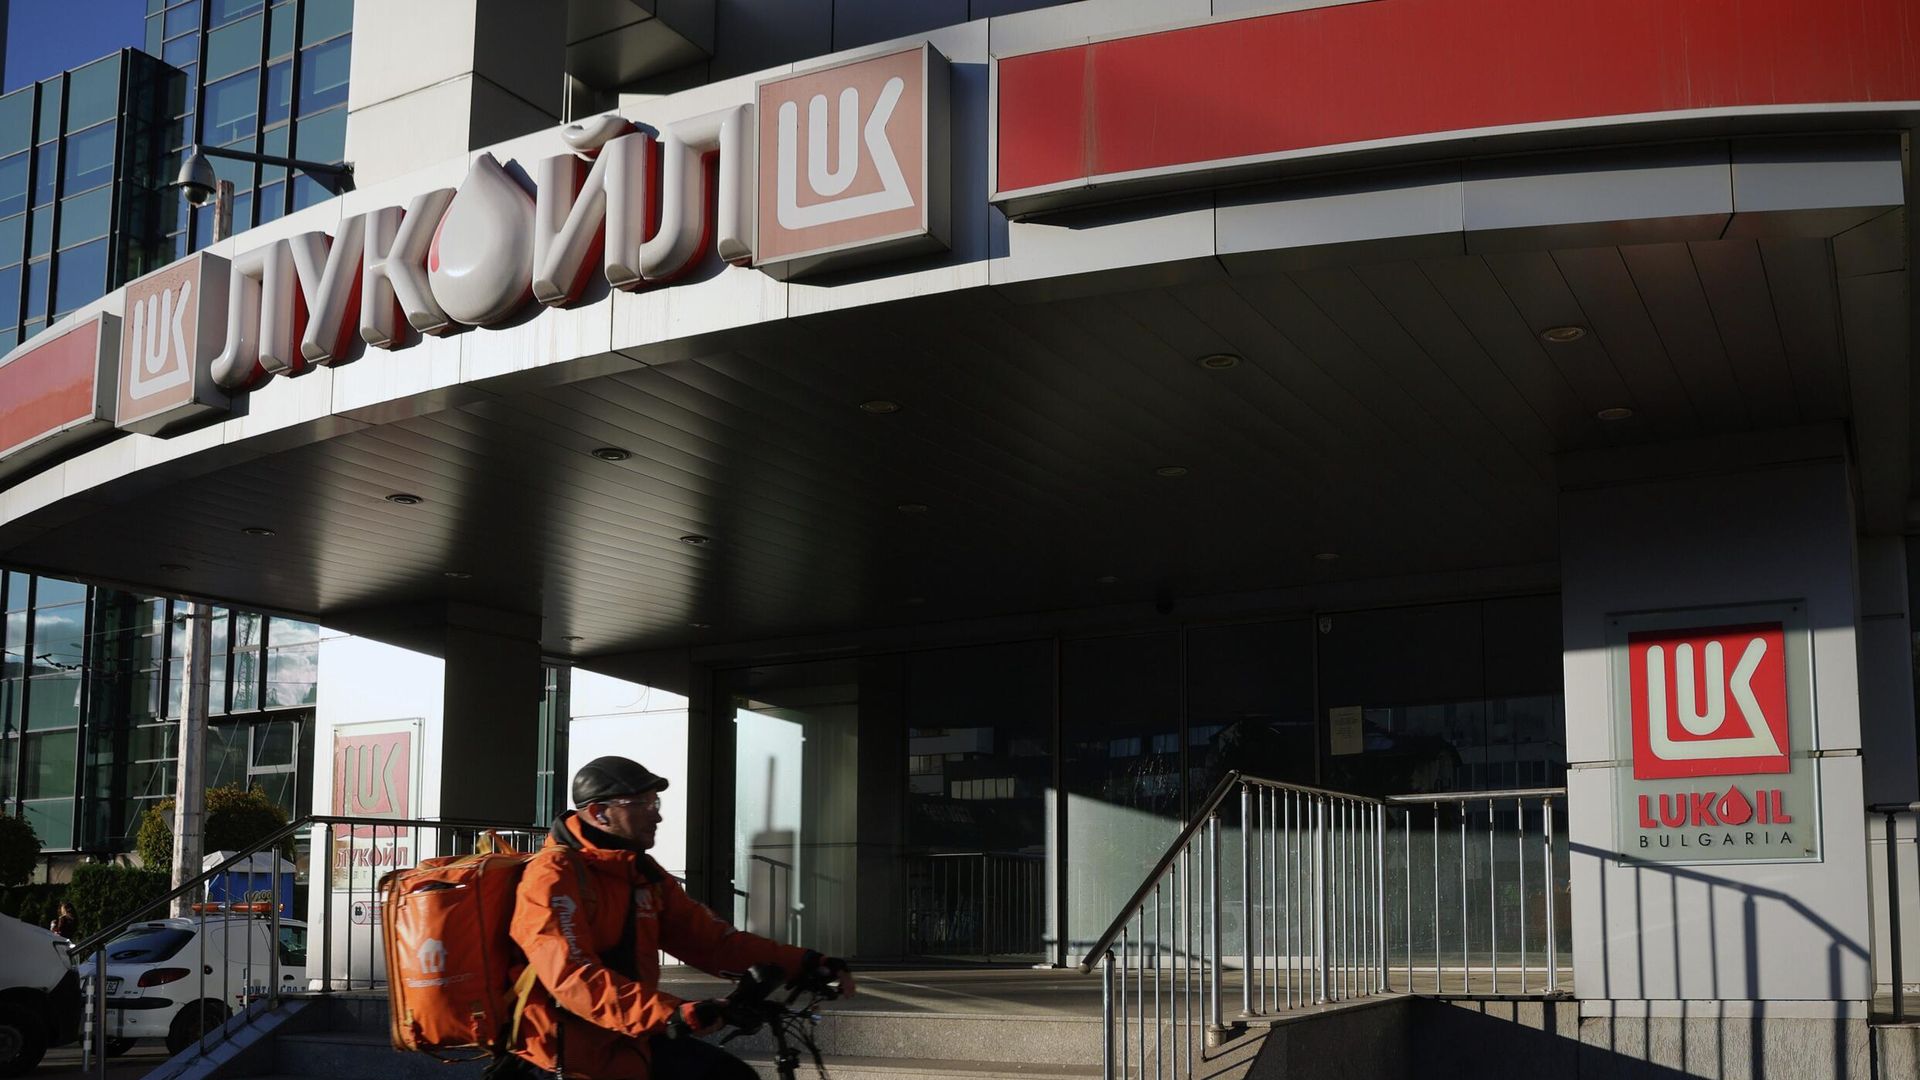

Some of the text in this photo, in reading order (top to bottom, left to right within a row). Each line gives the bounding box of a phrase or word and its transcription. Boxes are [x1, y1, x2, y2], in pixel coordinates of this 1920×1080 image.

[777, 76, 915, 230] LUK
[211, 114, 753, 388] ЛУКОЙЛ
[132, 279, 192, 400] LUK
[1647, 637, 1785, 760] LUK
[1638, 784, 1793, 829] LUKOIL
[1639, 831, 1793, 848] BULGARIA
